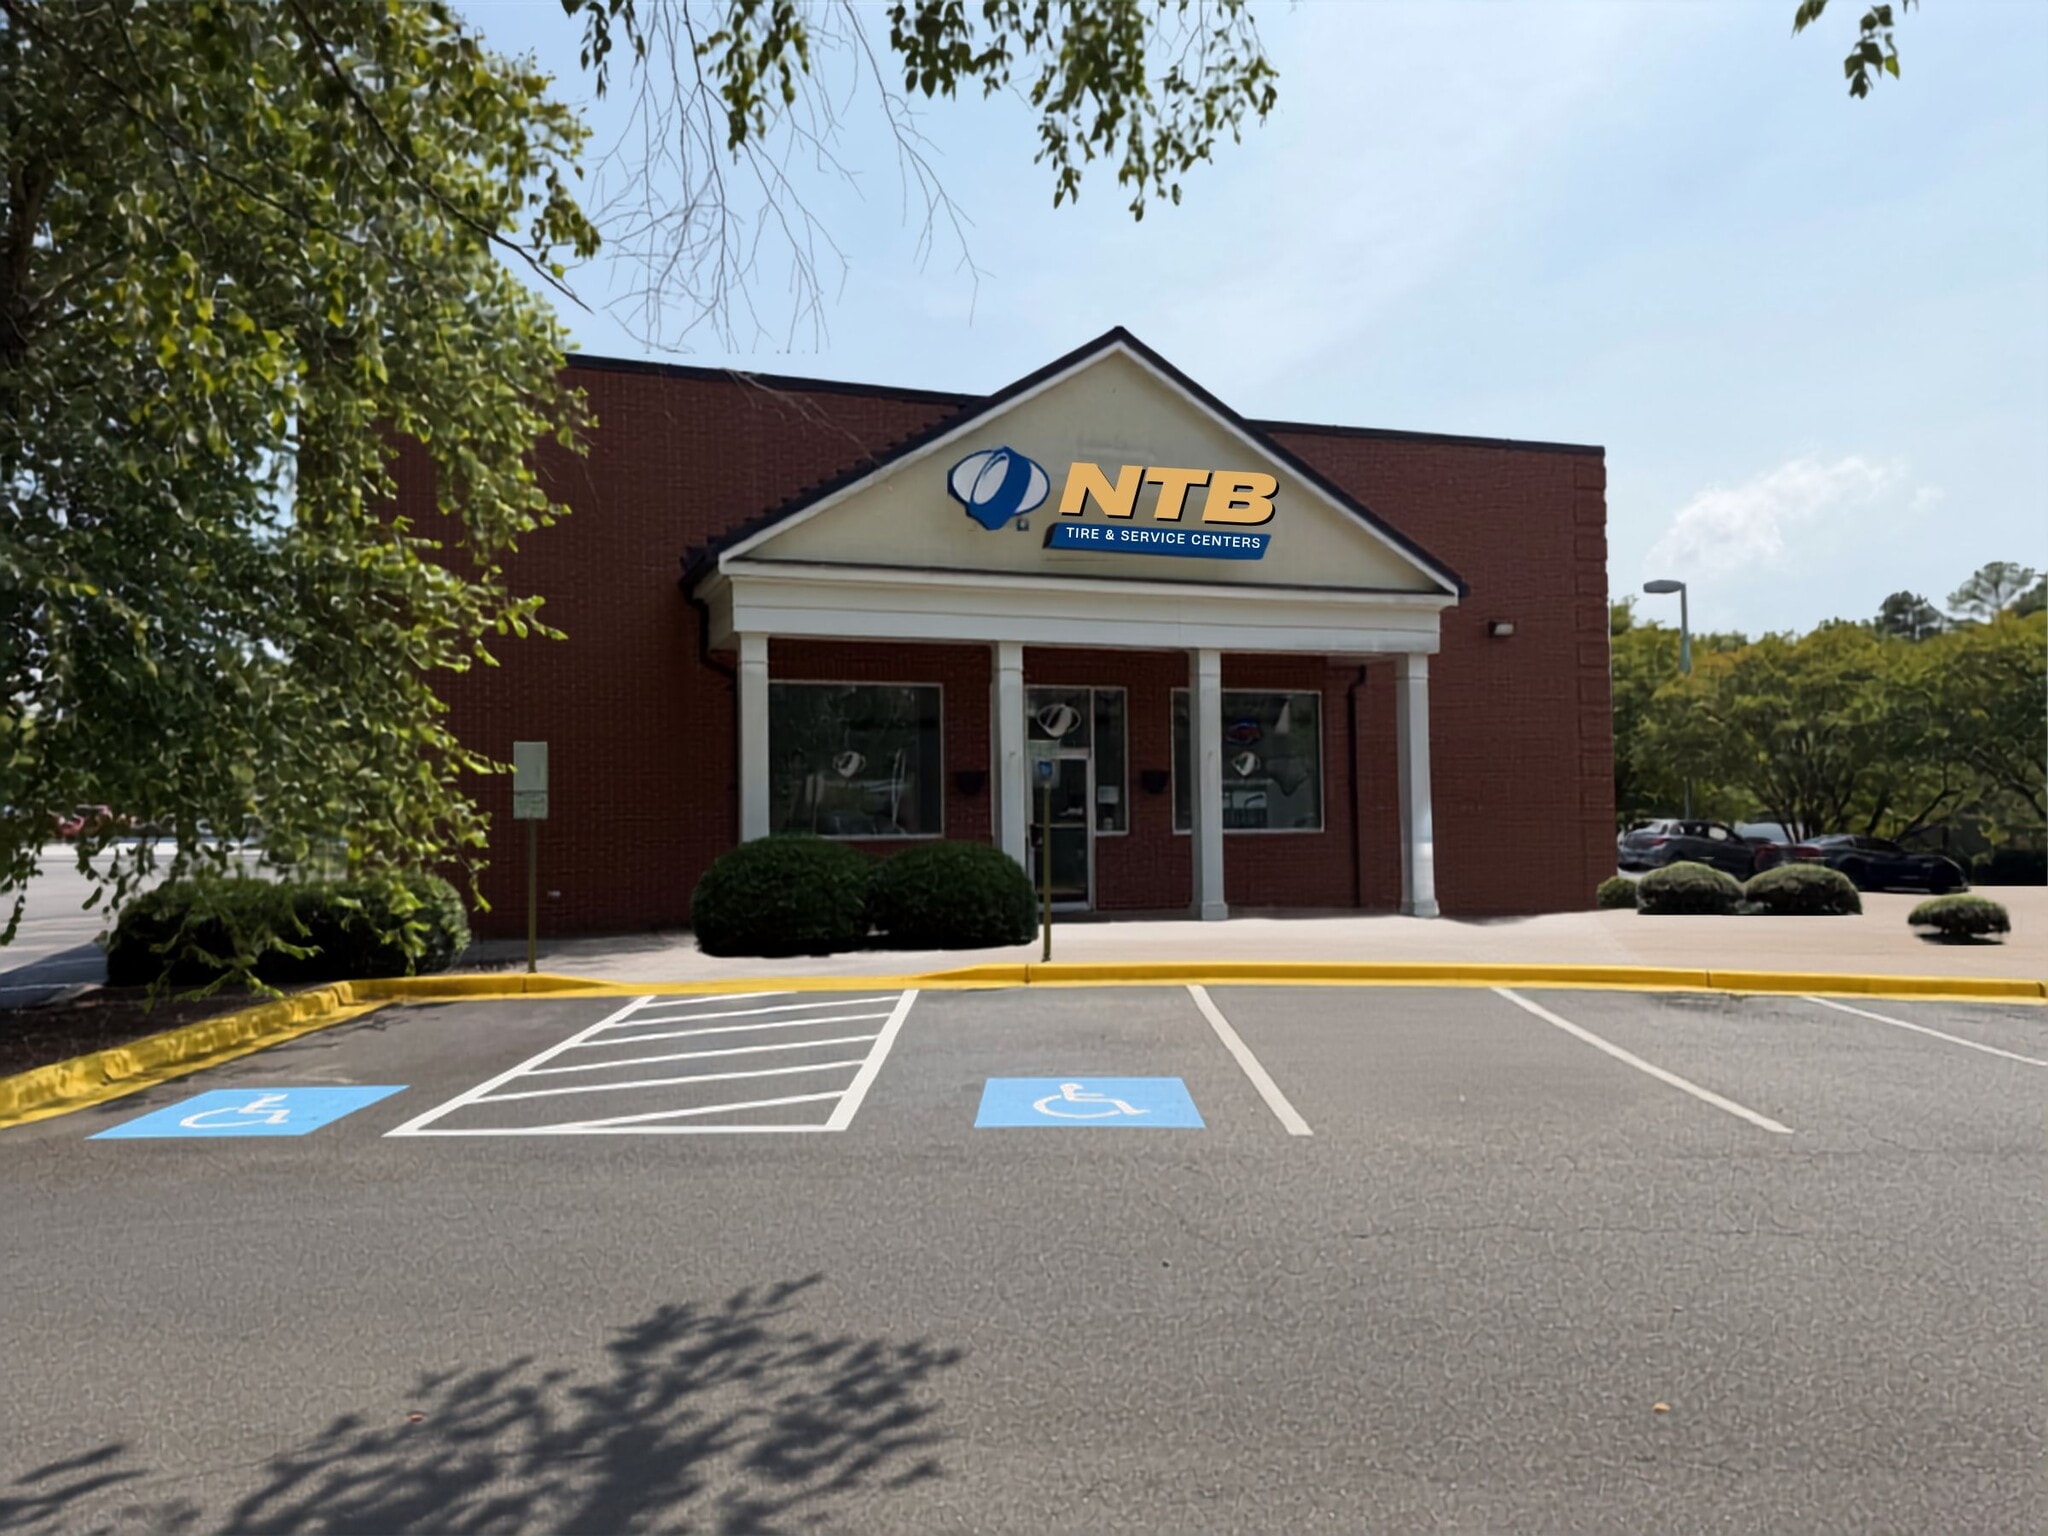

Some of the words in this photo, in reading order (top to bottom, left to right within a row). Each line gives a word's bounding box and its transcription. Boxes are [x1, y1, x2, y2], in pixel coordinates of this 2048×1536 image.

[1059, 462, 1279, 526] NTB
[1066, 527, 1100, 540] TIRE
[1105, 529, 1115, 541] &
[1120, 530, 1186, 545] SERVICE
[1190, 534, 1261, 549] CENTERS
